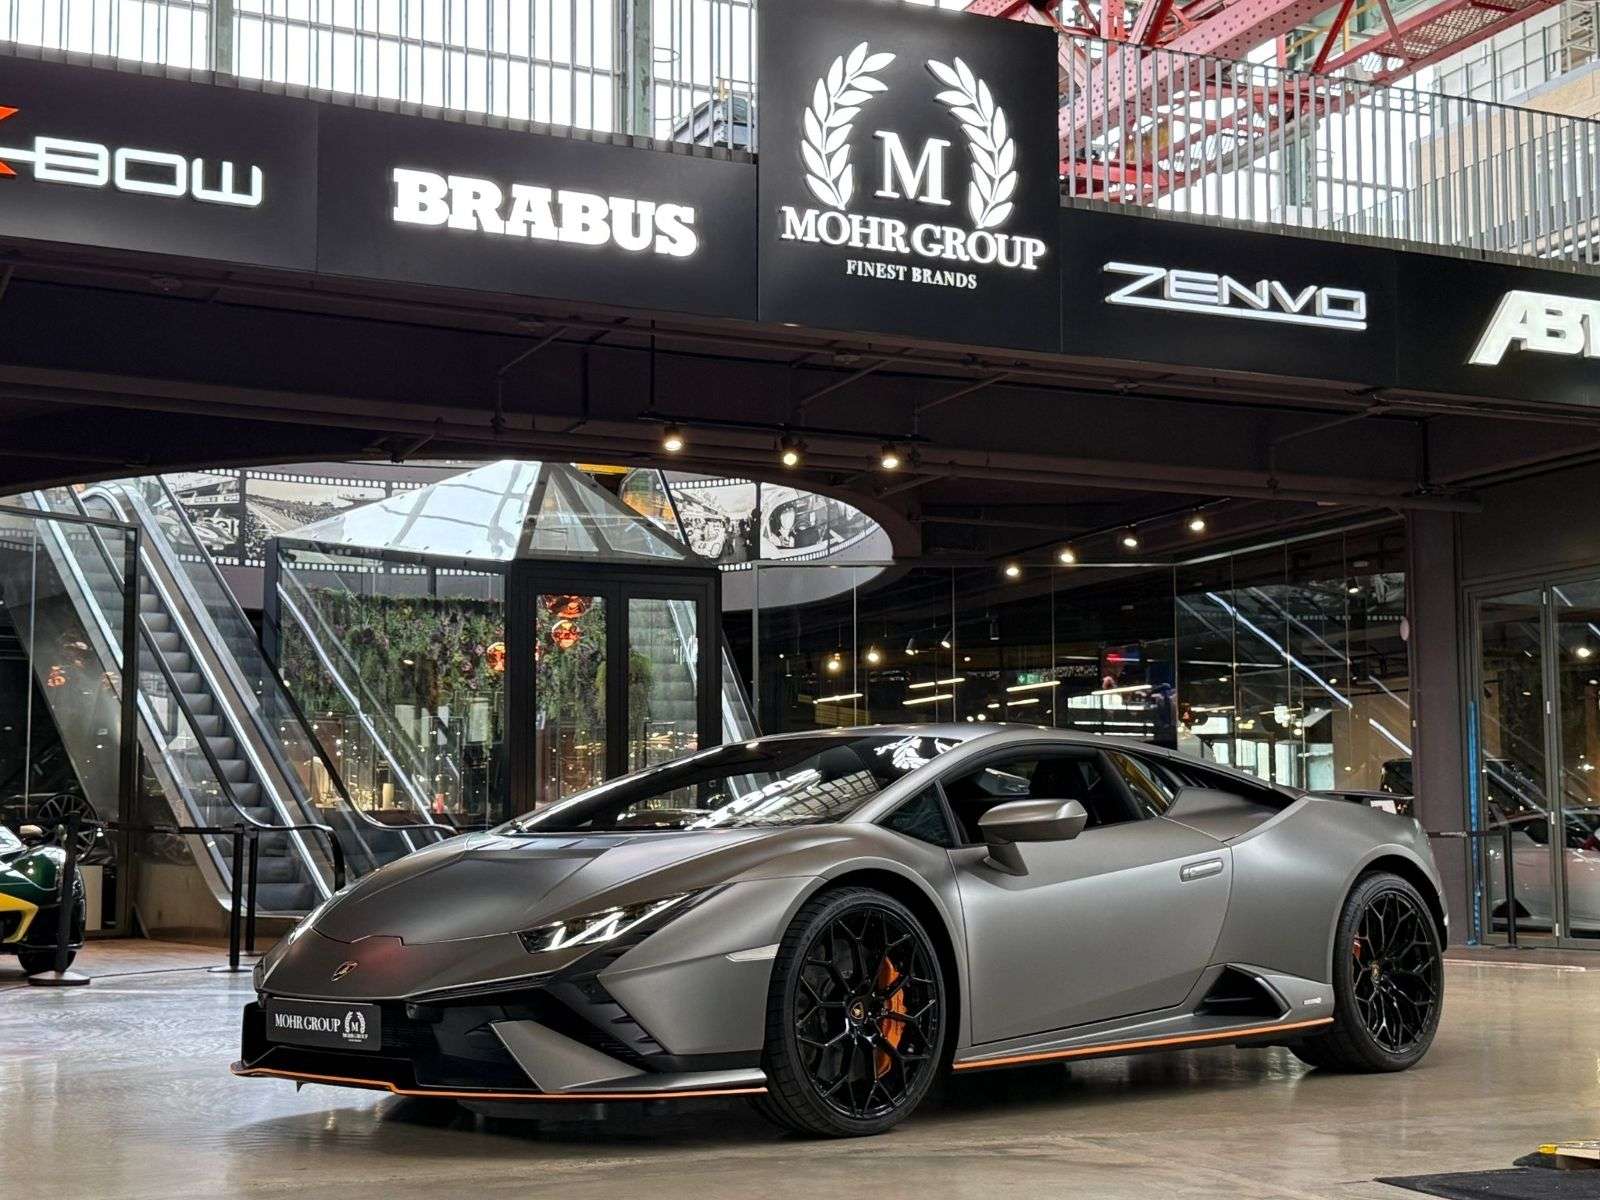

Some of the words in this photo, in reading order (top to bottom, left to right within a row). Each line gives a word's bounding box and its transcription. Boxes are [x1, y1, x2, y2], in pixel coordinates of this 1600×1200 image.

[872, 130, 952, 206] M
[392, 167, 698, 257] BRABUS
[780, 205, 910, 254] MOHR
[911, 222, 1047, 271] GROUP
[845, 259, 909, 282] FINEST
[911, 266, 978, 290] BRANDS
[1103, 261, 1367, 330] ZENVO
[275, 1012, 303, 1030] MOHR
[303, 1016, 341, 1033] GROUP
